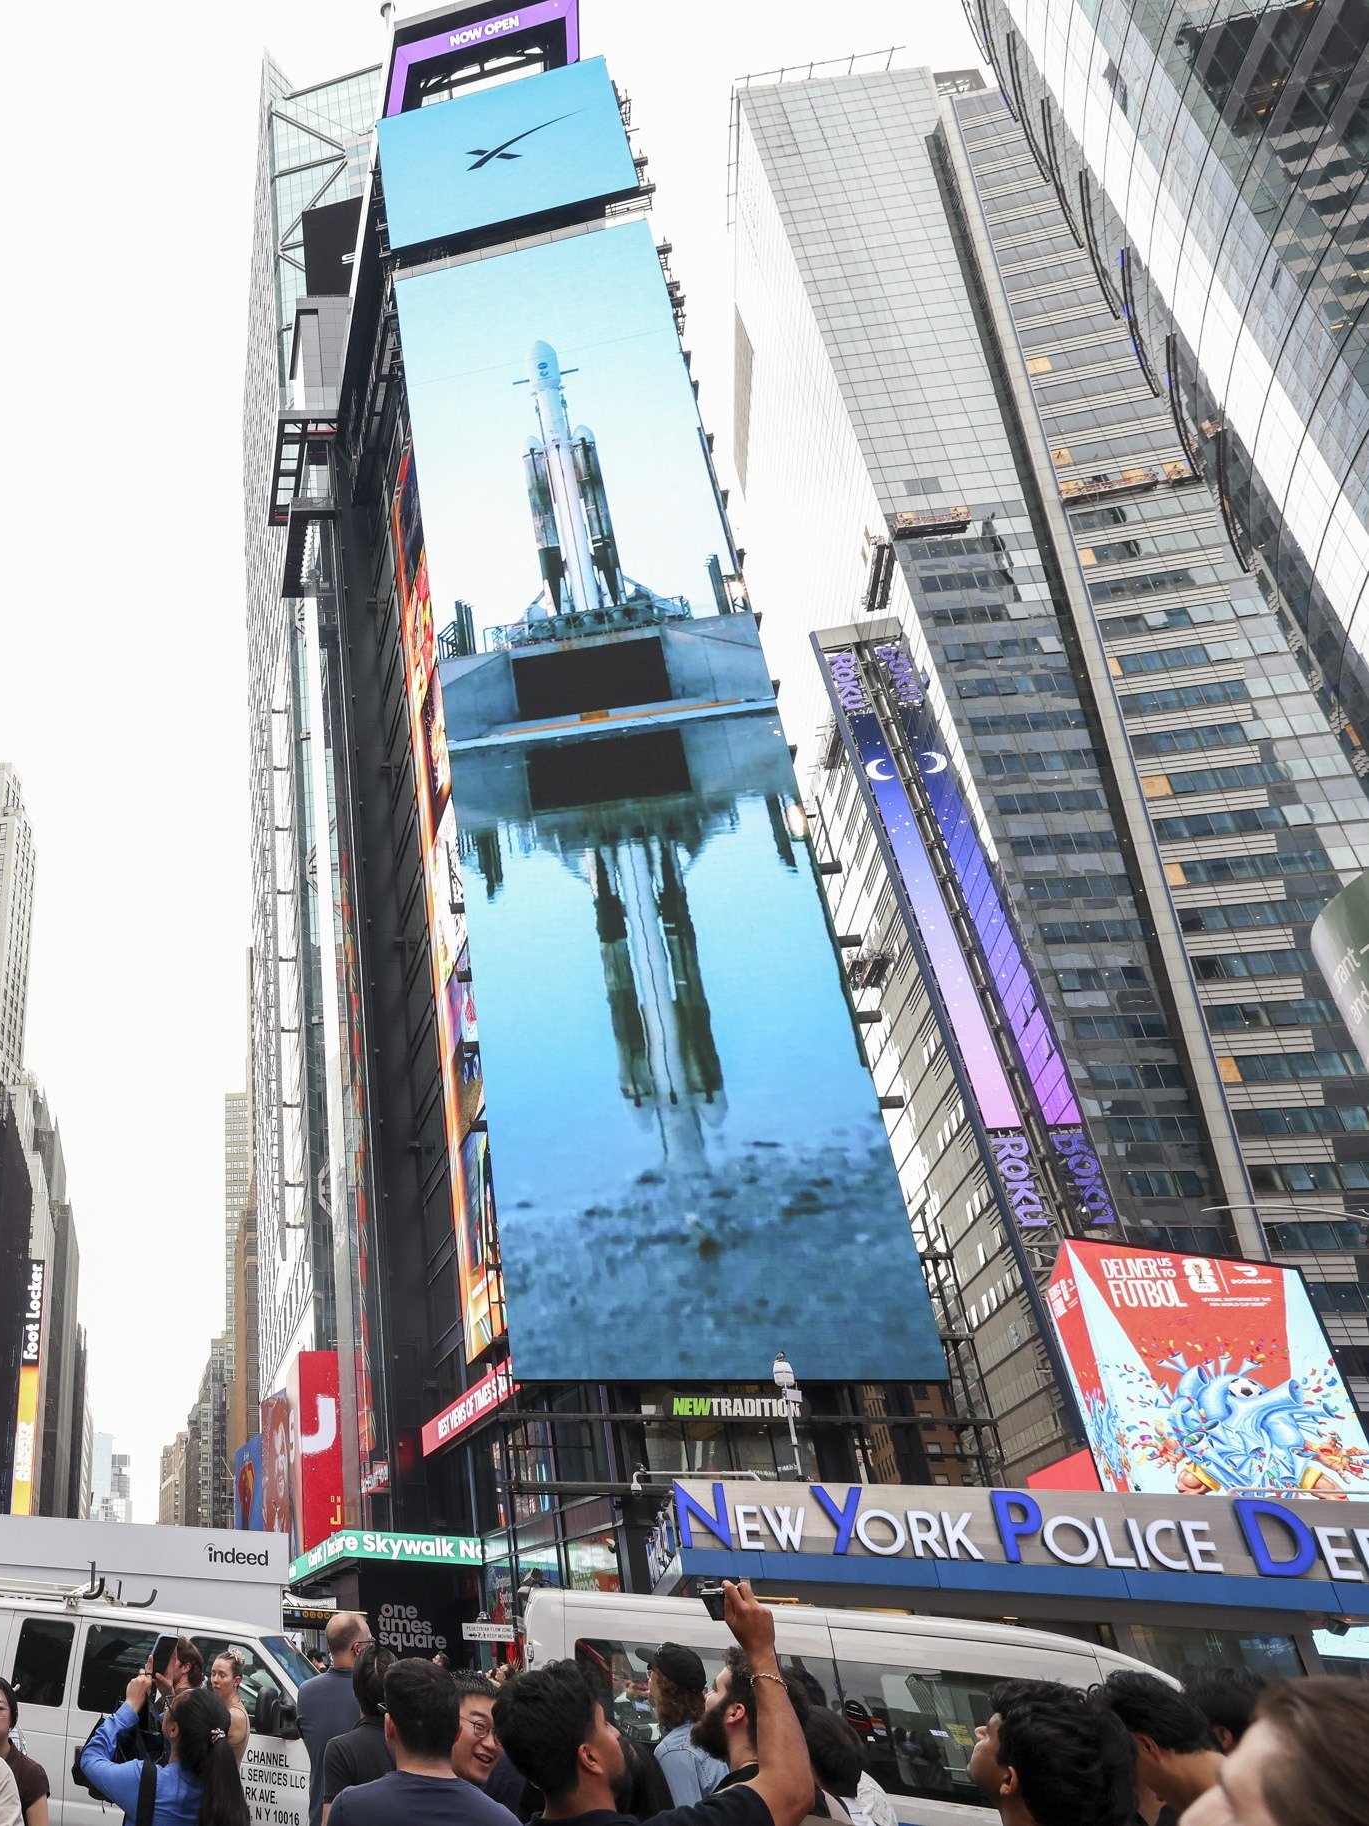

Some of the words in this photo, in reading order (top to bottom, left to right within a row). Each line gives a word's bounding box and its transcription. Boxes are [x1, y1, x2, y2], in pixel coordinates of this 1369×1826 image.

[449, 26, 482, 47] NOW
[484, 15, 520, 35] OPEN
[828, 653, 867, 711] ROKU
[991, 1136, 1049, 1227] ROKU
[1100, 1258, 1158, 1278] DELIVER
[1158, 1258, 1172, 1267] US
[1160, 1268, 1176, 1278] TO
[23, 1323, 40, 1360] Foot
[437, 1417, 451, 1440] BEST
[450, 1401, 467, 1431] VIEWS
[474, 1380, 493, 1412] TIMES
[673, 1480, 806, 1551] NEW
[809, 1485, 985, 1561] YORK
[989, 1490, 1224, 1574] POLICE
[205, 1544, 269, 1567] indeed
[363, 1533, 455, 1559] Skywalk
[381, 1603, 418, 1620] one
[378, 1615, 432, 1635] times
[379, 1631, 447, 1652] square
[247, 1750, 290, 1768] CHANNEL
[247, 1768, 288, 1787] SERVICES
[290, 1775, 306, 1789] LLC
[258, 1788, 278, 1805] AVE.
[273, 1809, 300, 1826] 10016
